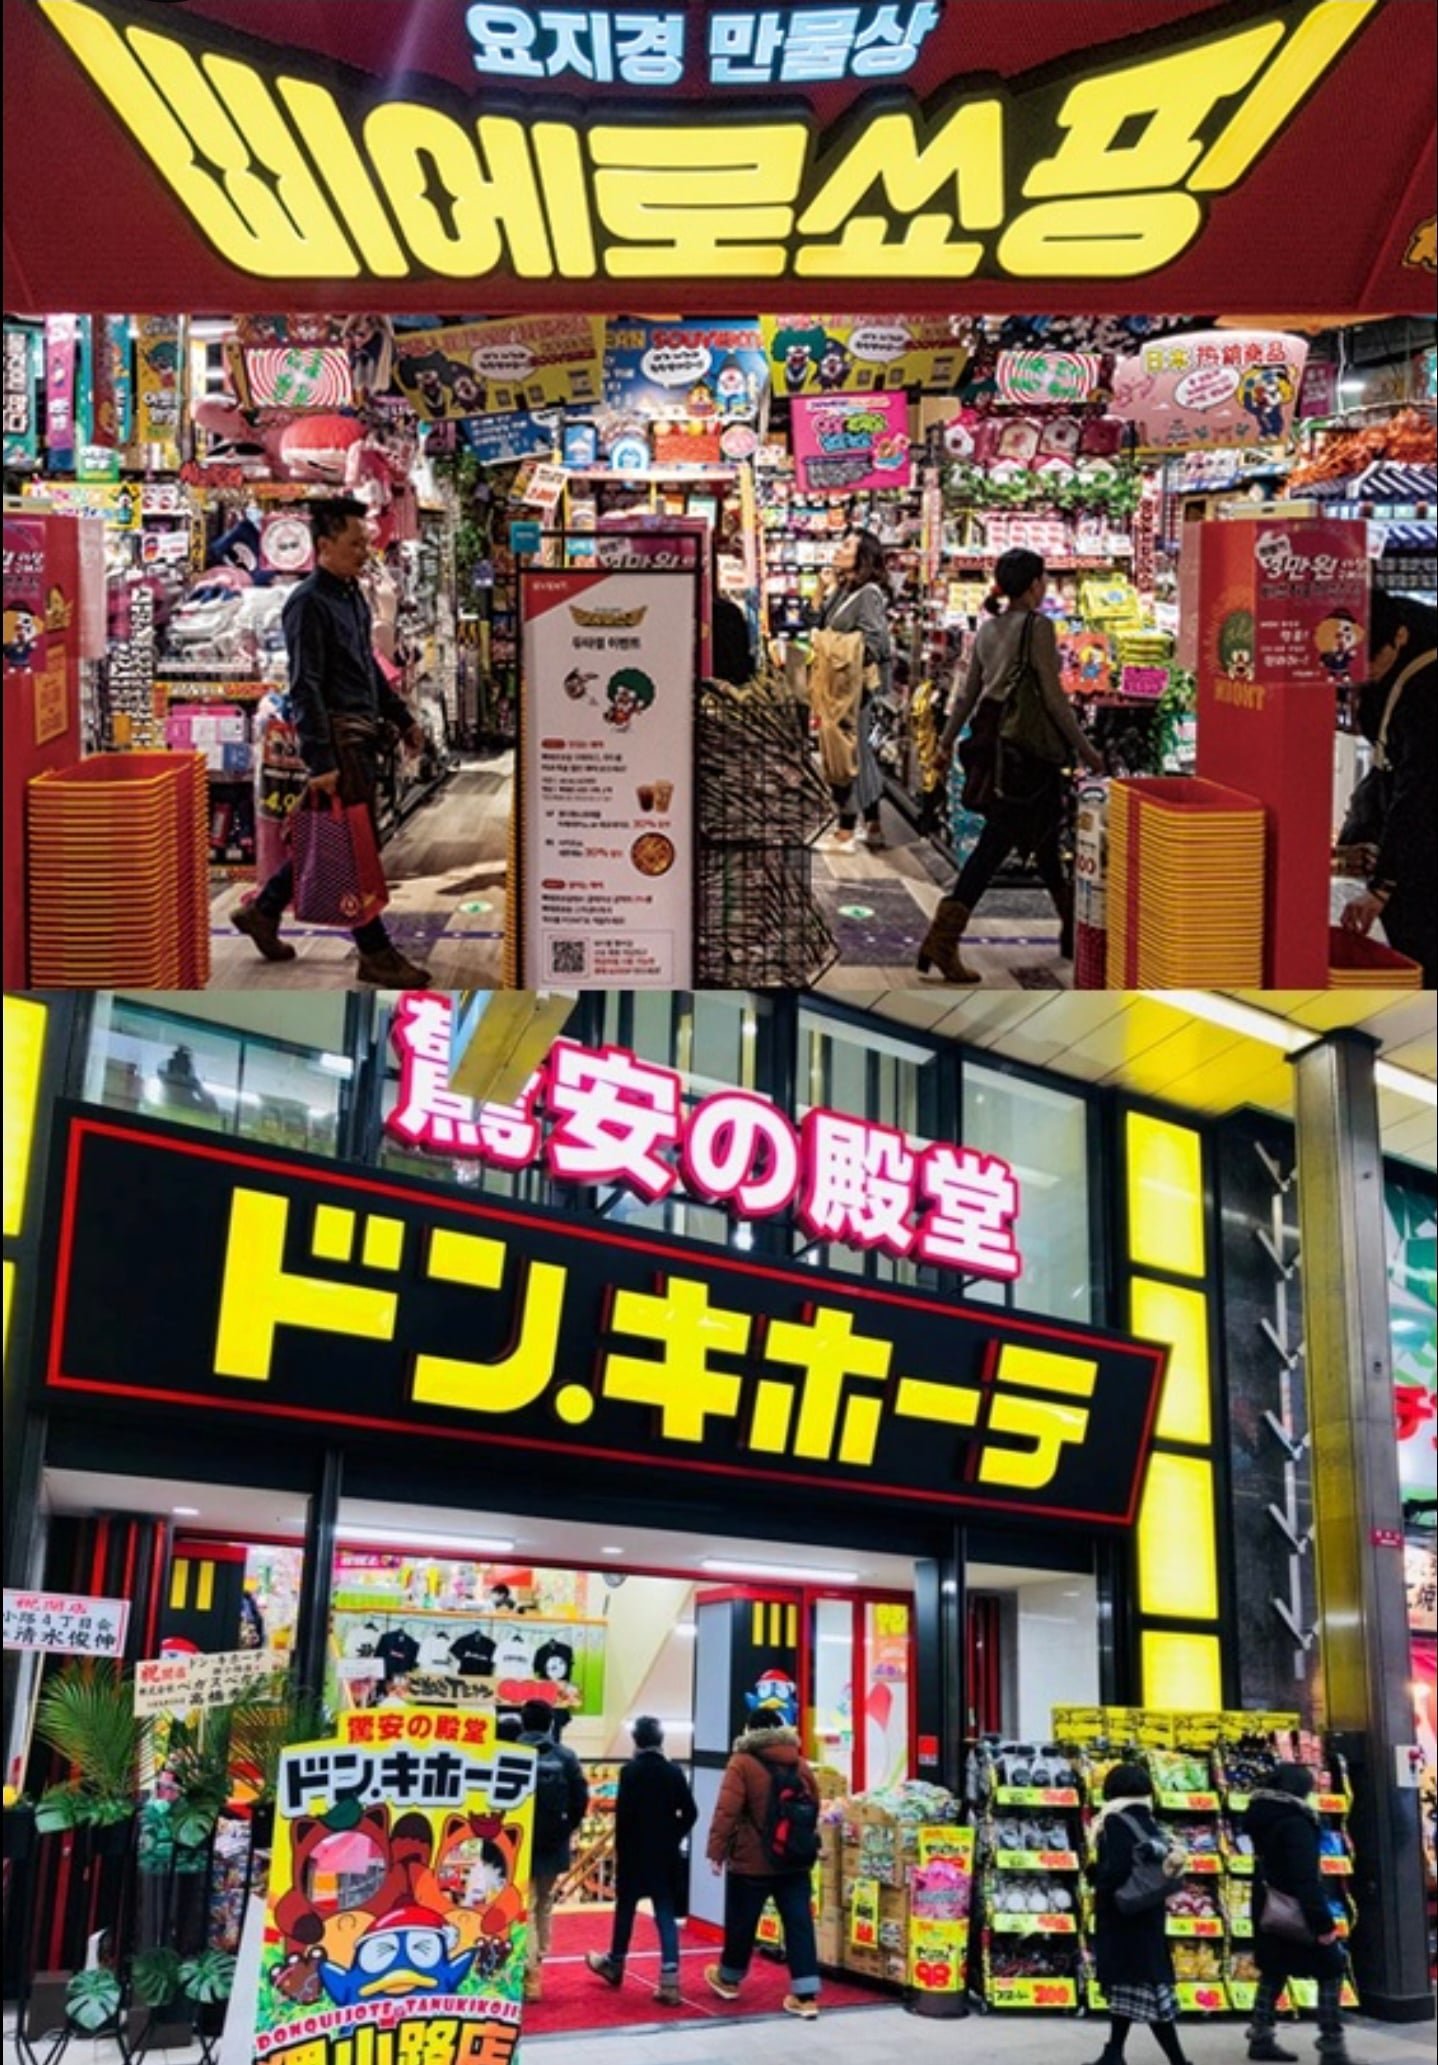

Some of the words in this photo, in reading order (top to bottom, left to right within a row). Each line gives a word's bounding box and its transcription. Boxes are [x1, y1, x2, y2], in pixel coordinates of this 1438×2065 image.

[466, 3, 684, 85] 요지경
[709, 2, 940, 84] 만물상
[37, 0, 1380, 278] 삐에로쑈핑
[1145, 347, 1190, 370] 日本
[347, 1713, 489, 1745] 驚安の殿堂
